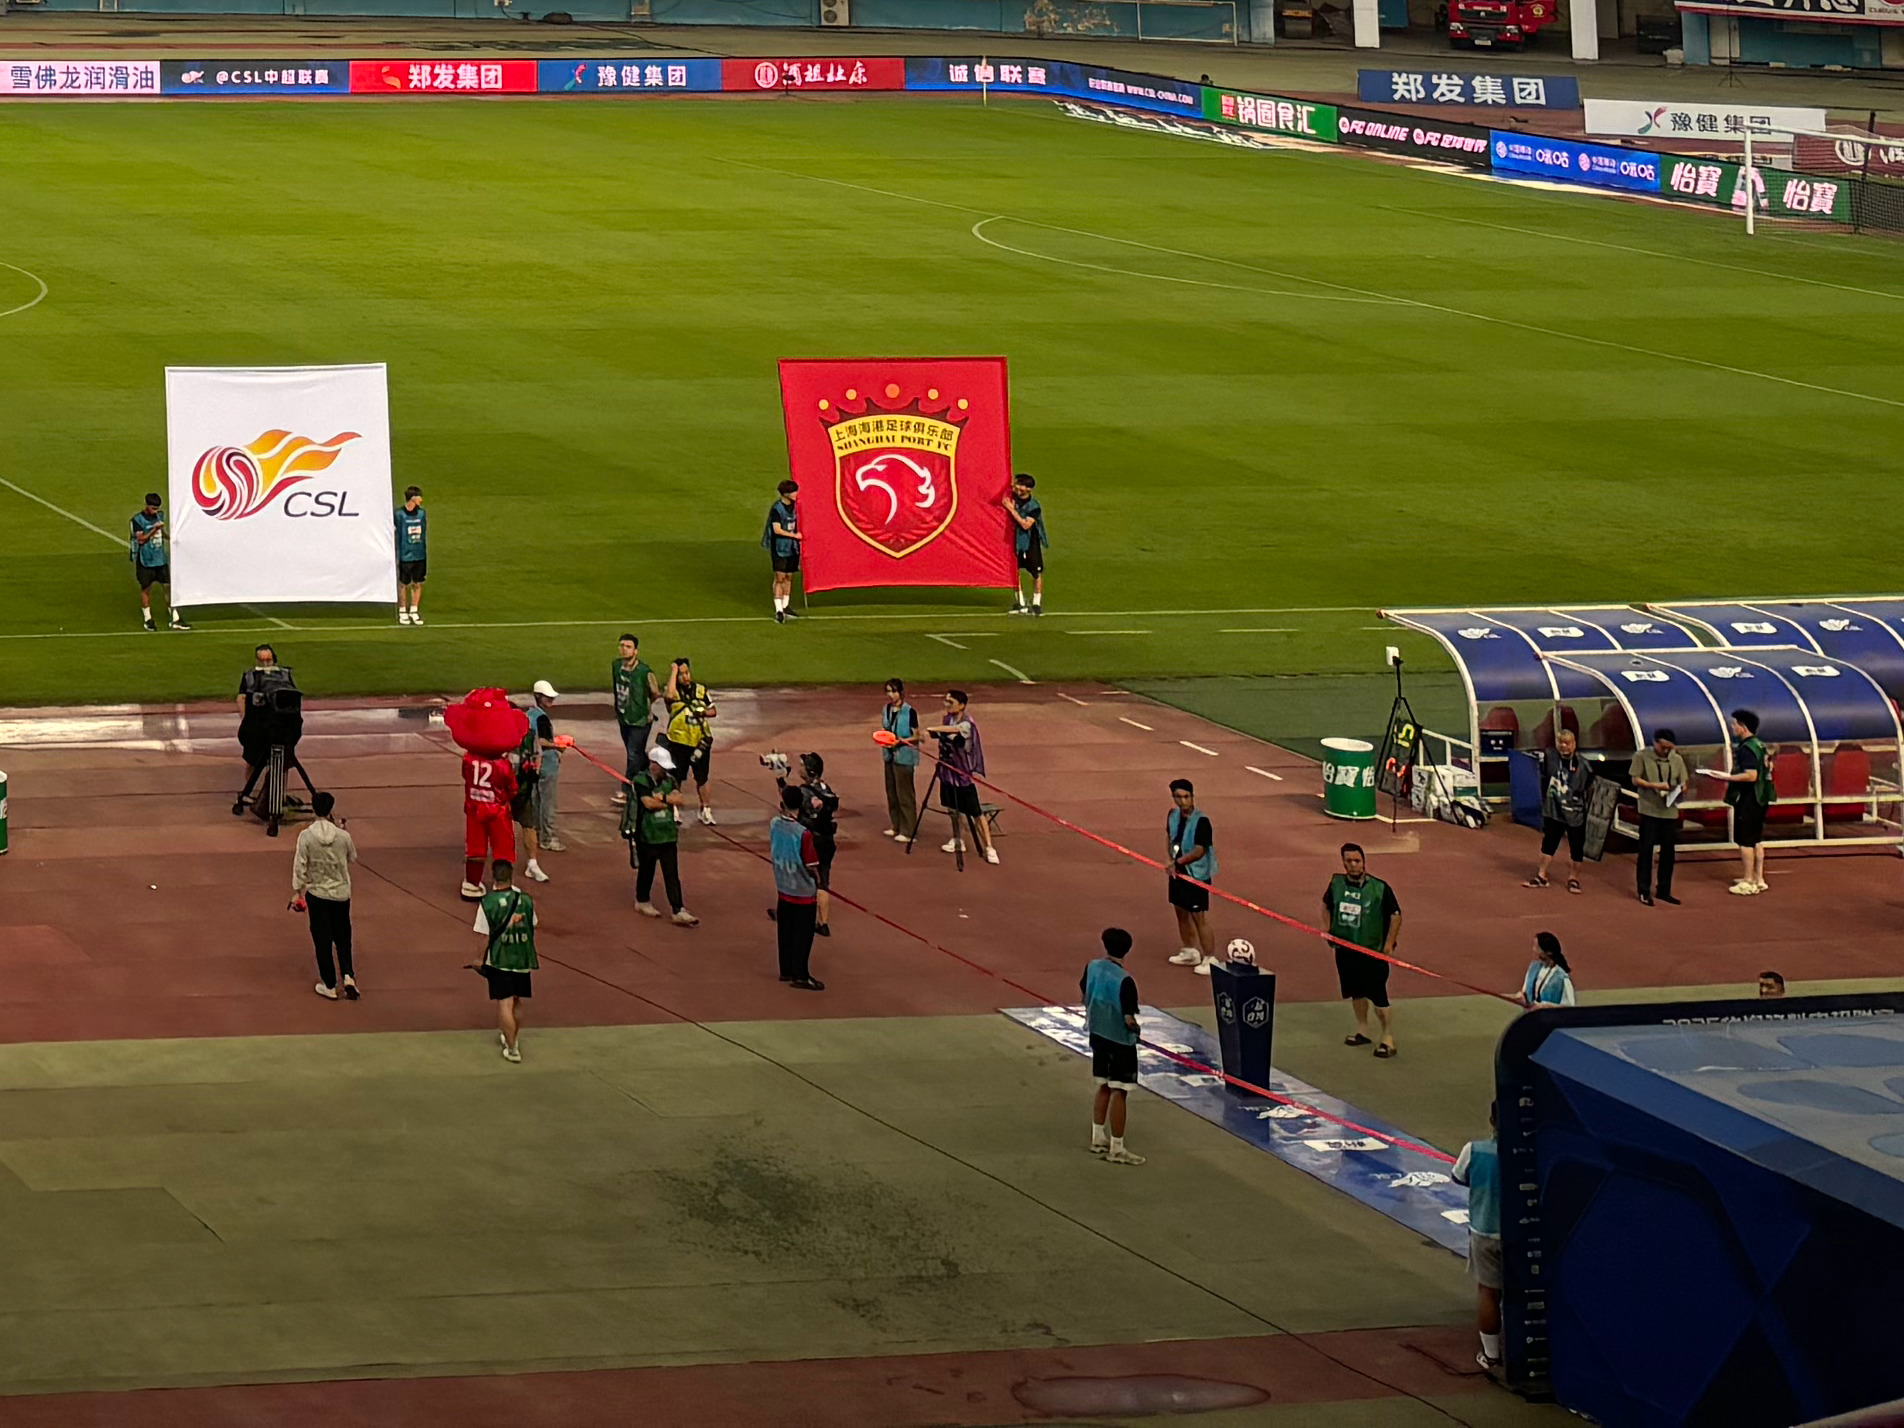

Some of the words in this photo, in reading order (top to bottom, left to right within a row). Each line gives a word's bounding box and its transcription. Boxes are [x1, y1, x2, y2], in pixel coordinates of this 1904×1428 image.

[10, 65, 154, 90] 雪佛龙润滑油
[216, 69, 329, 85] @CSL中超联赛
[408, 64, 502, 90] 郑发集团
[598, 65, 686, 88] 豫健集团
[949, 64, 1046, 85] 诚信联赛
[1392, 72, 1546, 106] 郑发集团
[1237, 96, 1316, 134] 锅圈食汇
[1671, 112, 1772, 135] 豫健集团
[1366, 122, 1409, 142] ONLINE
[1670, 162, 1722, 198] 怡寶
[1783, 179, 1838, 214] 怡寶
[834, 419, 954, 442] 上海海港足球俱乐部
[837, 434, 896, 452] SHANGHAI
[900, 434, 934, 448] PORT
[936, 440, 952, 452] FC
[284, 491, 359, 518] CSL
[471, 760, 492, 788] 12
